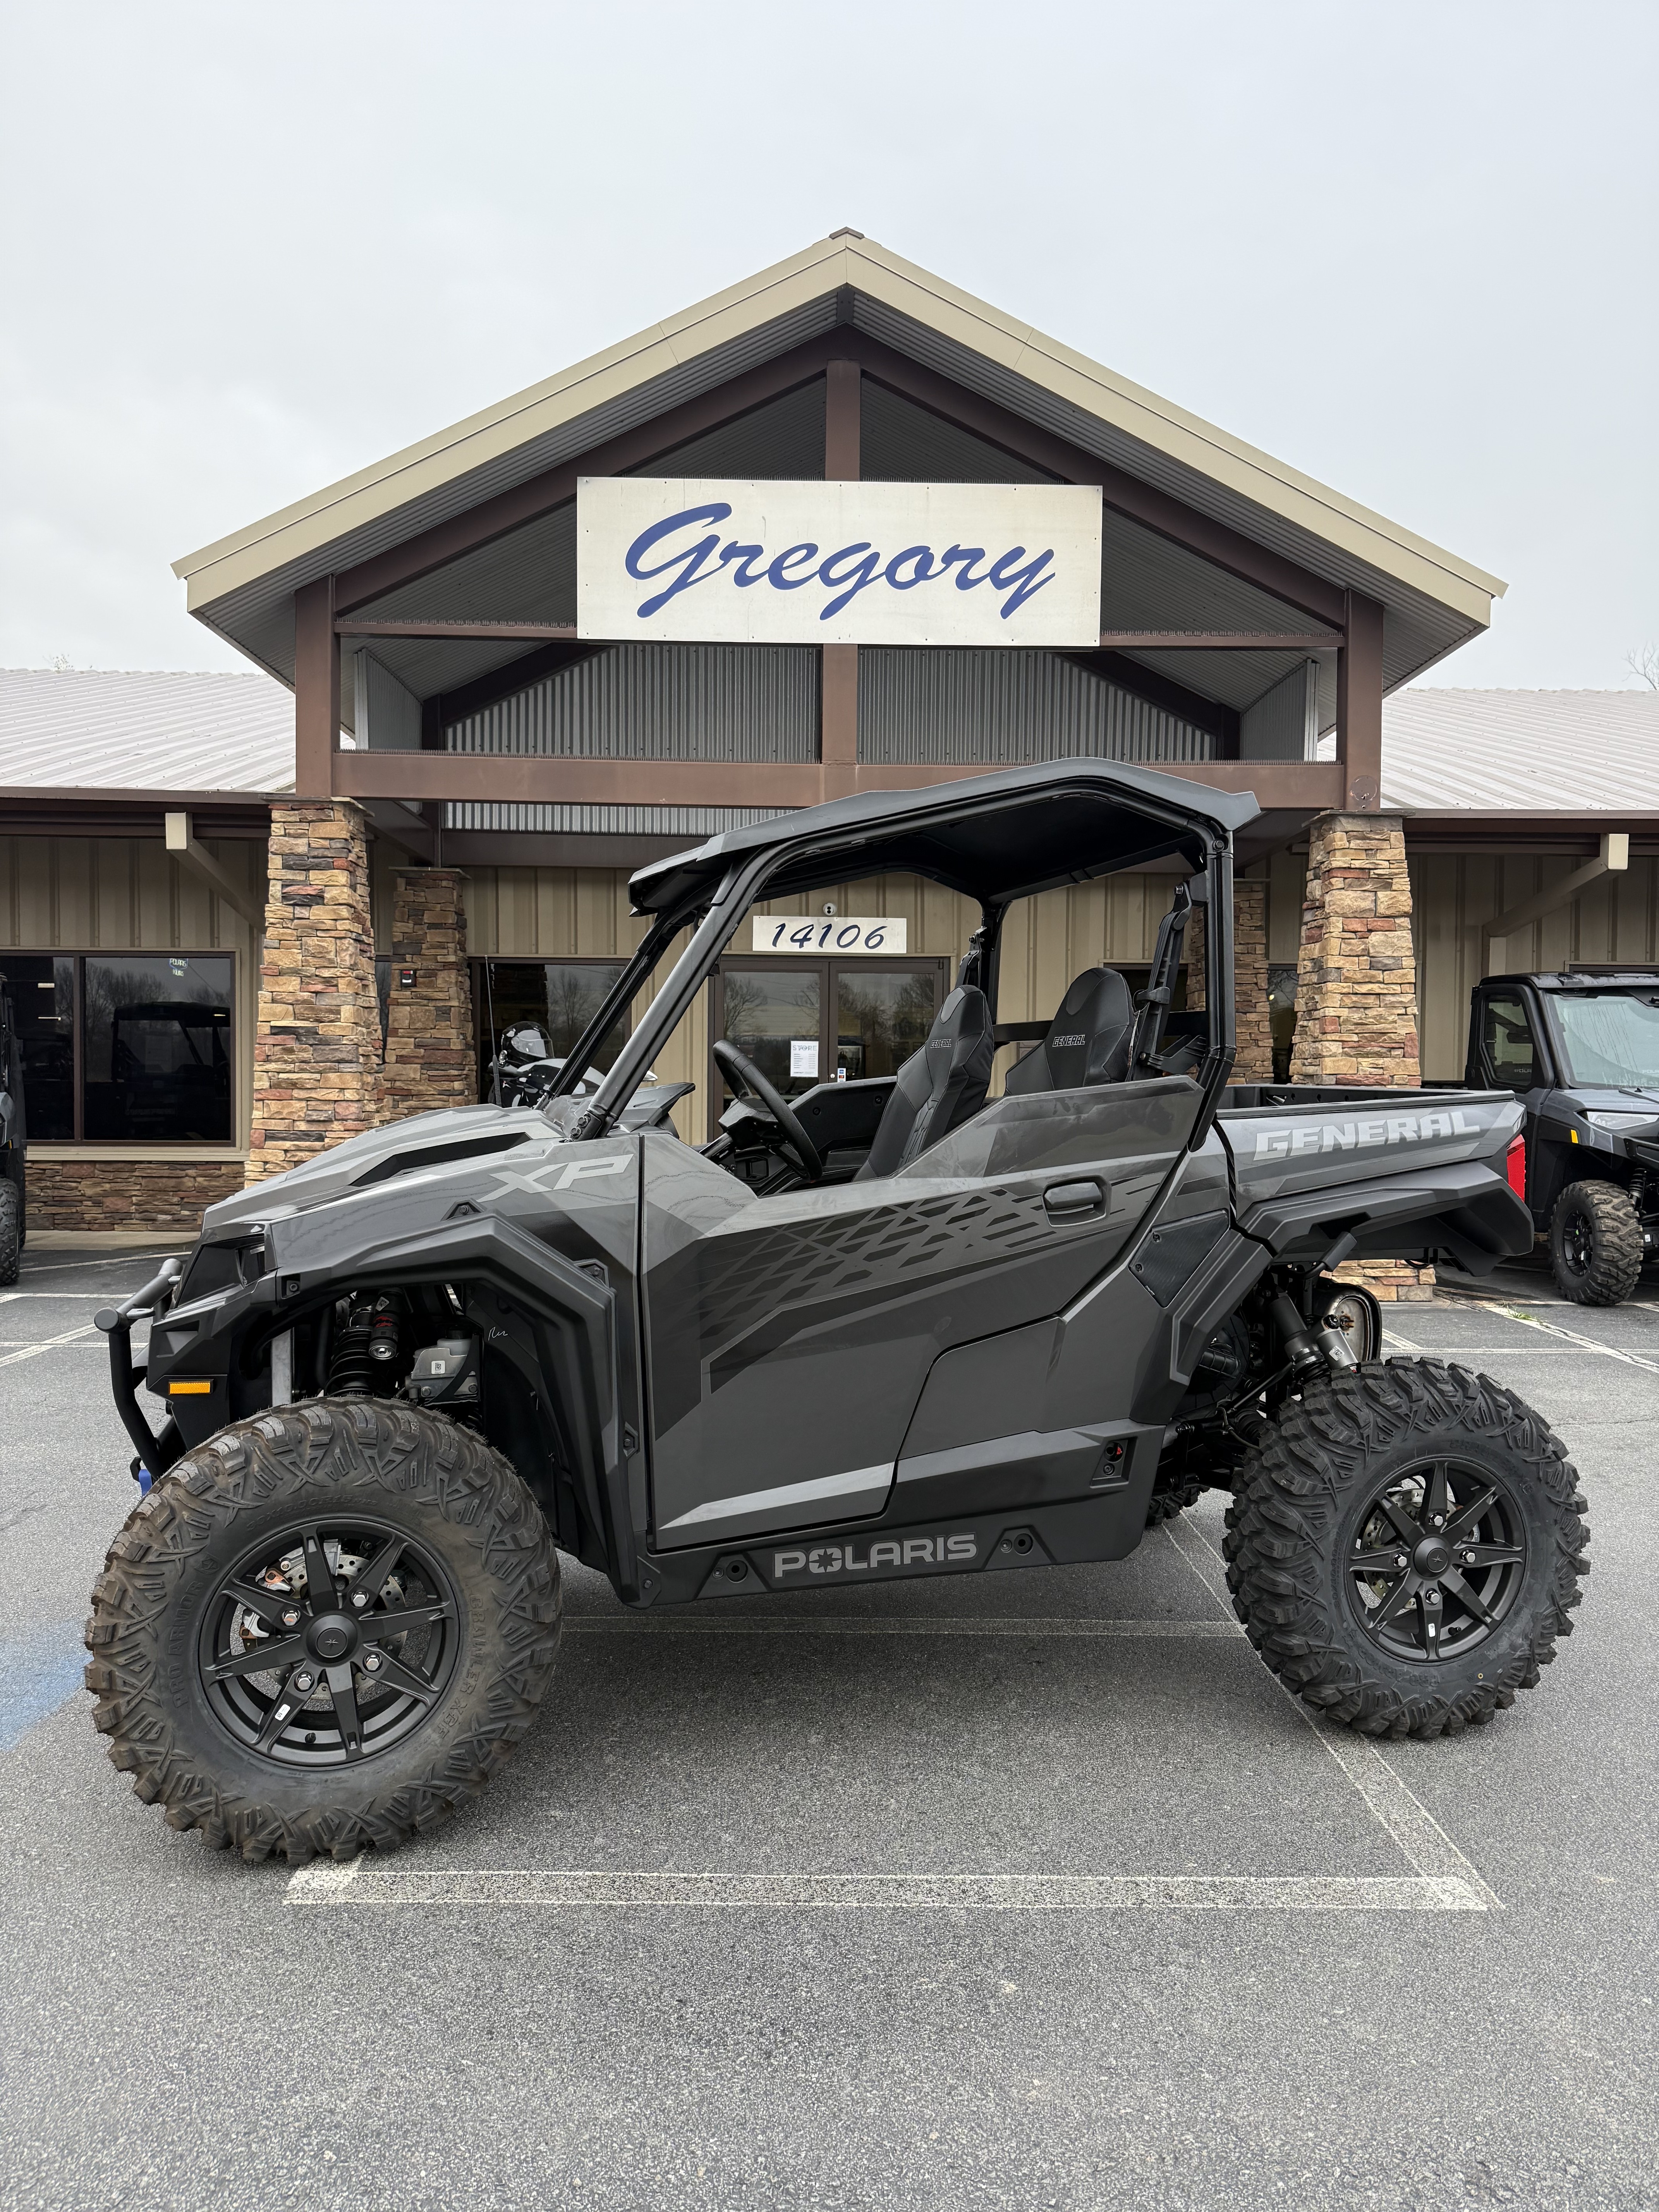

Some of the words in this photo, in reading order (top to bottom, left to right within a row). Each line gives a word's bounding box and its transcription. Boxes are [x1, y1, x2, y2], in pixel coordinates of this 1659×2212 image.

[625, 503, 1056, 620] Gregory
[772, 922, 888, 949] 14106
[930, 1039, 951, 1049] GENERAL
[1052, 1035, 1085, 1047] GENERAL
[1254, 1112, 1480, 1161] GENERAL
[476, 1154, 634, 1202] XP
[774, 1534, 977, 1578] POLARIS
[168, 1581, 204, 1656] ARMOR
[460, 1594, 486, 1695] CRAWLER
[168, 1663, 189, 1708] PRO
